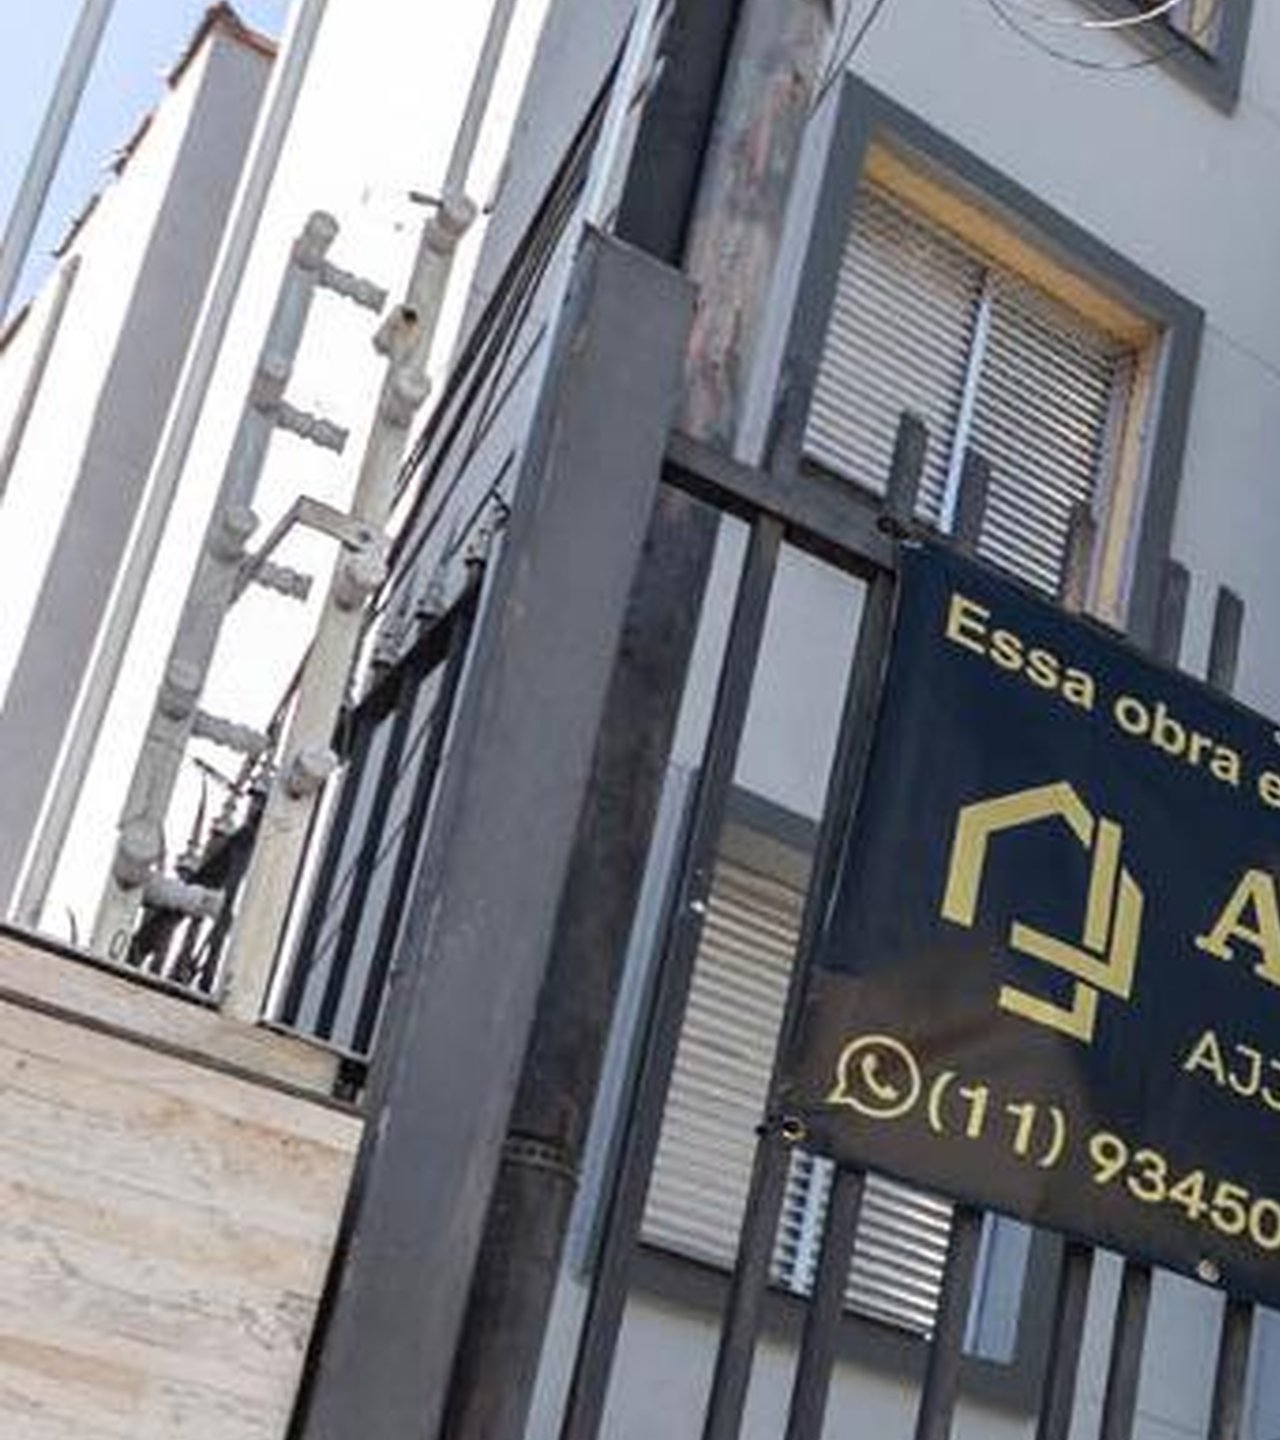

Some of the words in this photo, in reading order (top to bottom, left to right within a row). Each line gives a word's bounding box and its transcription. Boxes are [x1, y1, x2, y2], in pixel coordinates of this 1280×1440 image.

[944, 591, 1095, 711] Essa
[1113, 693, 1240, 786] obra
[926, 1070, 1067, 1168] (11)
